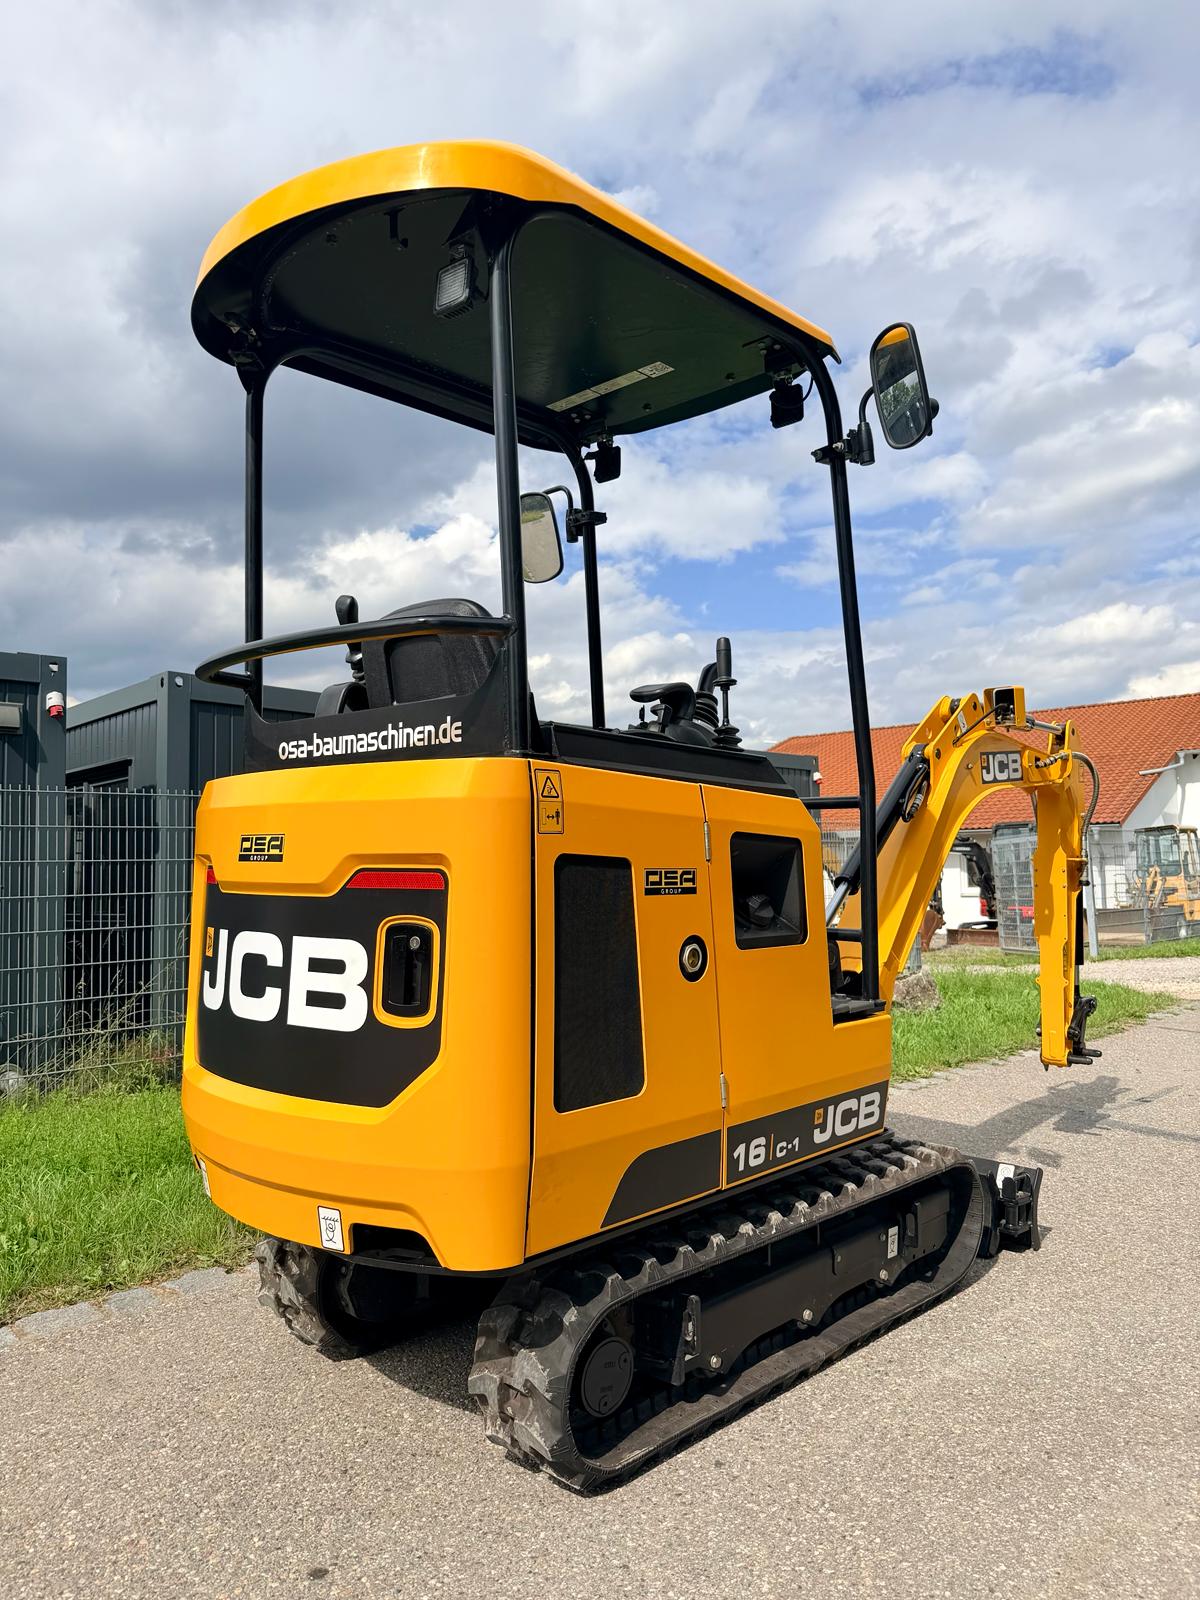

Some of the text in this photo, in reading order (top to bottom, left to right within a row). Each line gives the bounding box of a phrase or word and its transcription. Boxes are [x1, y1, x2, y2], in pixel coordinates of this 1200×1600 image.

[278, 715, 462, 760] osa-baumaschinen.de
[982, 753, 1023, 782] JCB
[202, 928, 369, 1033] JCB
[813, 1091, 881, 1144] JCB
[733, 1136, 767, 1172] 16
